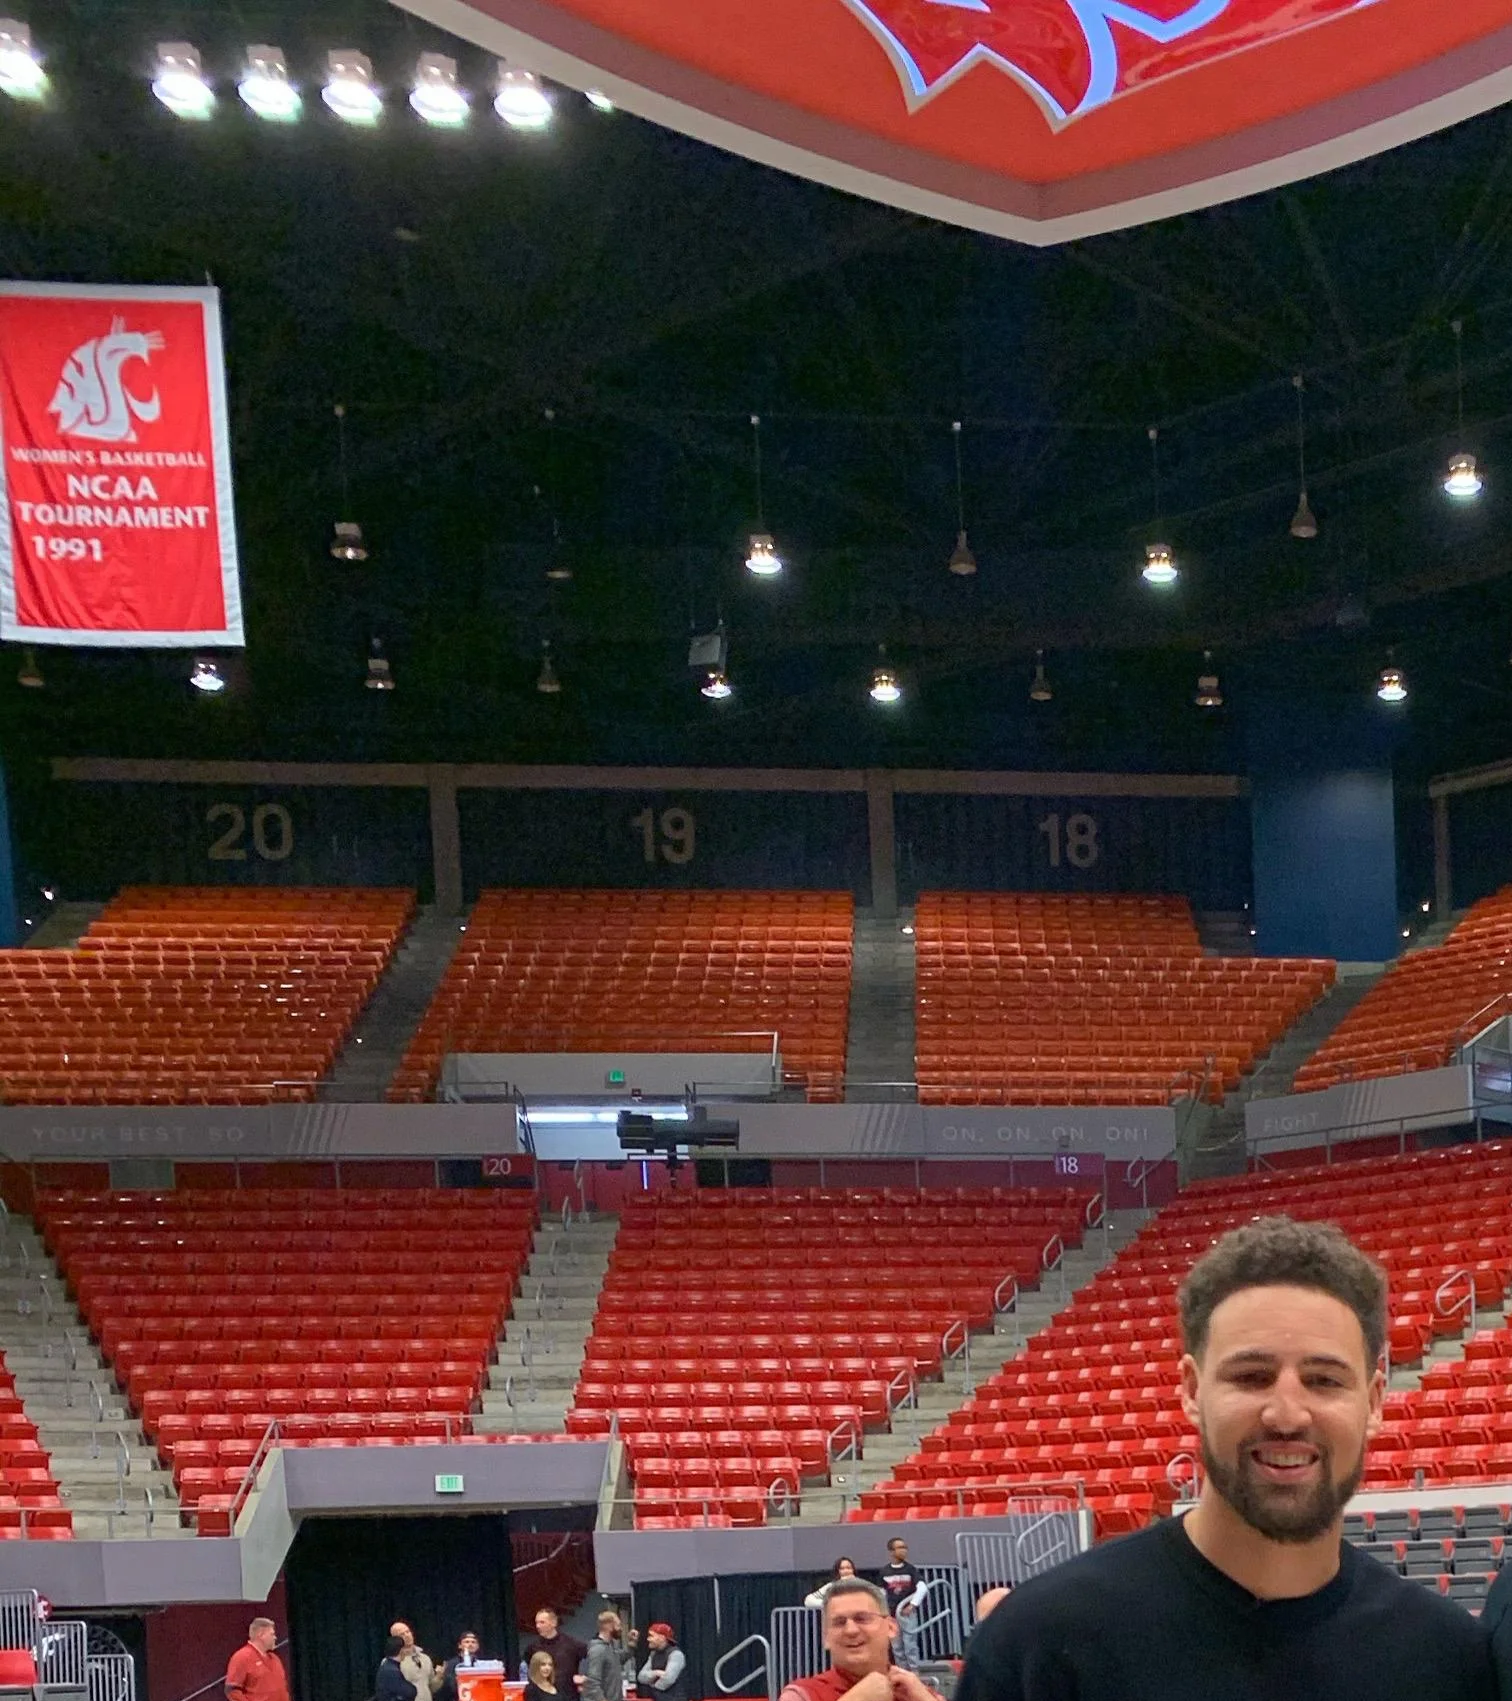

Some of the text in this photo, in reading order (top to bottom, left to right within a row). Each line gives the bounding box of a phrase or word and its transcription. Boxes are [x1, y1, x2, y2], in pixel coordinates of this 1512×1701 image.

[11, 446, 208, 468] WOMEN'S BASKETBALL
[66, 473, 159, 501] NCAA
[16, 500, 209, 528] TOURNAMENT
[32, 534, 104, 562] 1991
[206, 803, 294, 861] 20
[631, 808, 697, 865] 19
[1039, 812, 1099, 868] 18
[32, 1126, 105, 1143] YOUR
[488, 1158, 512, 1176] 20
[1060, 1156, 1079, 1174] 18
